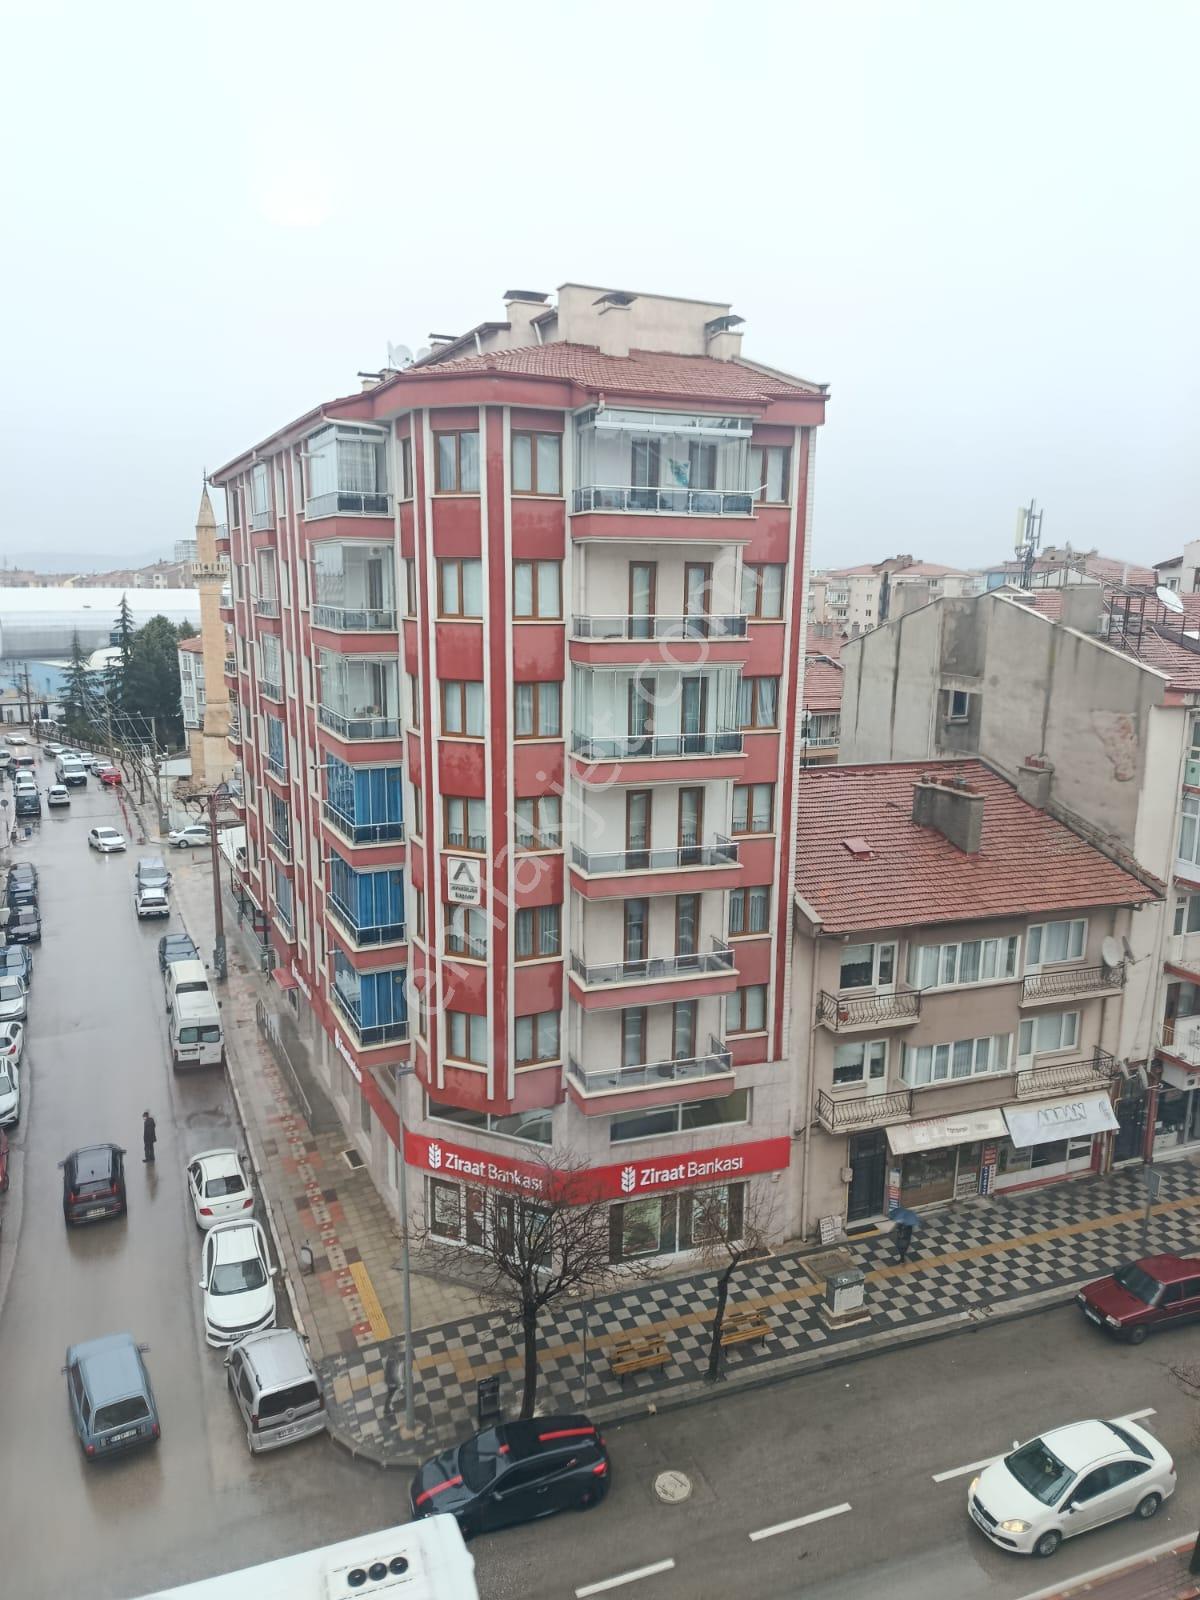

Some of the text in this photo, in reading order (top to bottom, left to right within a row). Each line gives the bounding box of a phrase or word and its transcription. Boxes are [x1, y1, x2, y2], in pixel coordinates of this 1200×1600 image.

[445, 1152, 543, 1192] Ziraat Bankası
[640, 1157, 744, 1186] Ziraat Bankası
